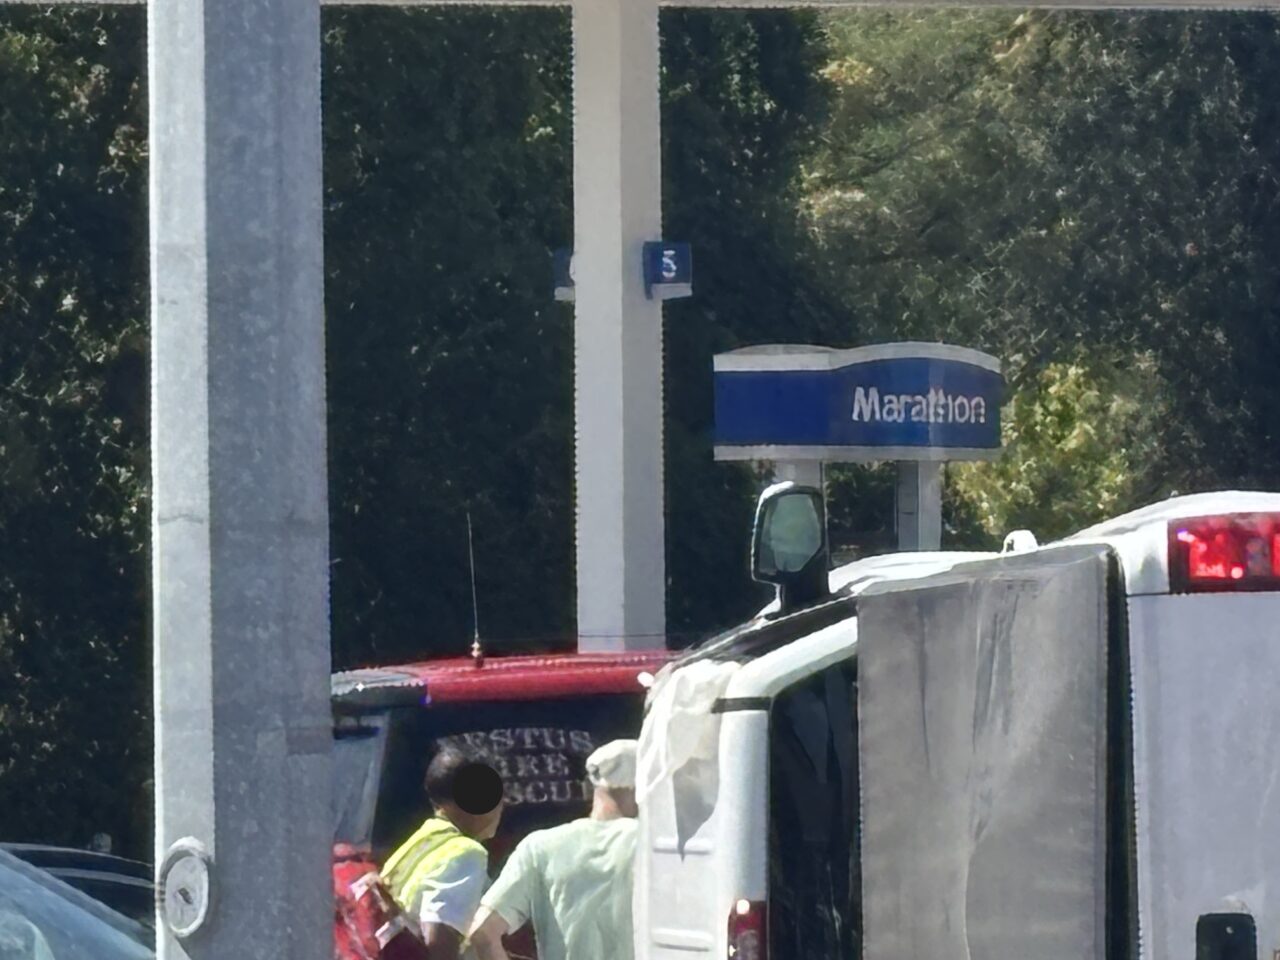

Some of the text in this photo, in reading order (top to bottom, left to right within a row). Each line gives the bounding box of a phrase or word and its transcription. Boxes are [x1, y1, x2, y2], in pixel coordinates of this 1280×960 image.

[662, 250, 677, 278] 5
[852, 387, 986, 424] Marathon
[436, 728, 595, 752] ESTUS
